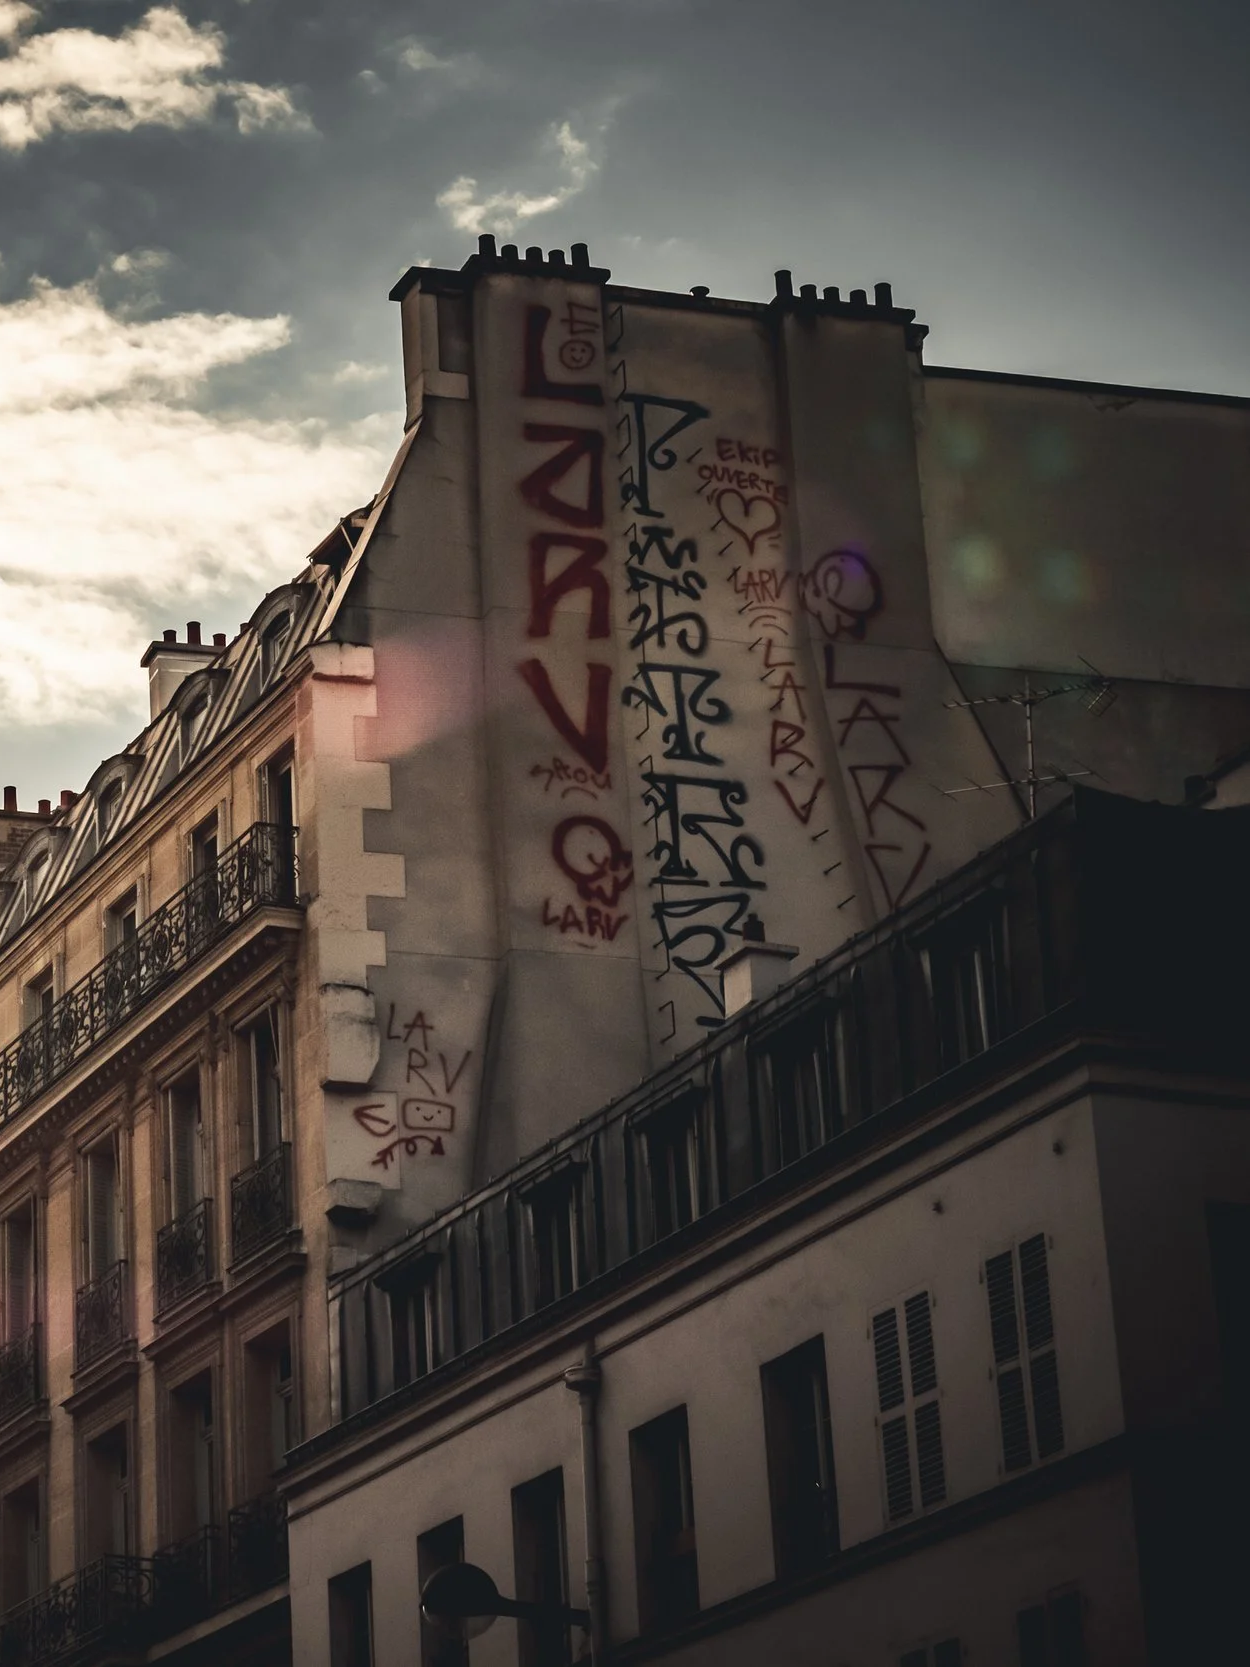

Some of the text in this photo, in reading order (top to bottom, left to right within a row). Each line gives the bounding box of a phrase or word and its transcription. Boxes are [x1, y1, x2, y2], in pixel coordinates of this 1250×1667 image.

[734, 568, 790, 602] LARV
[764, 639, 825, 825] LARV
[542, 898, 629, 941] LARV
